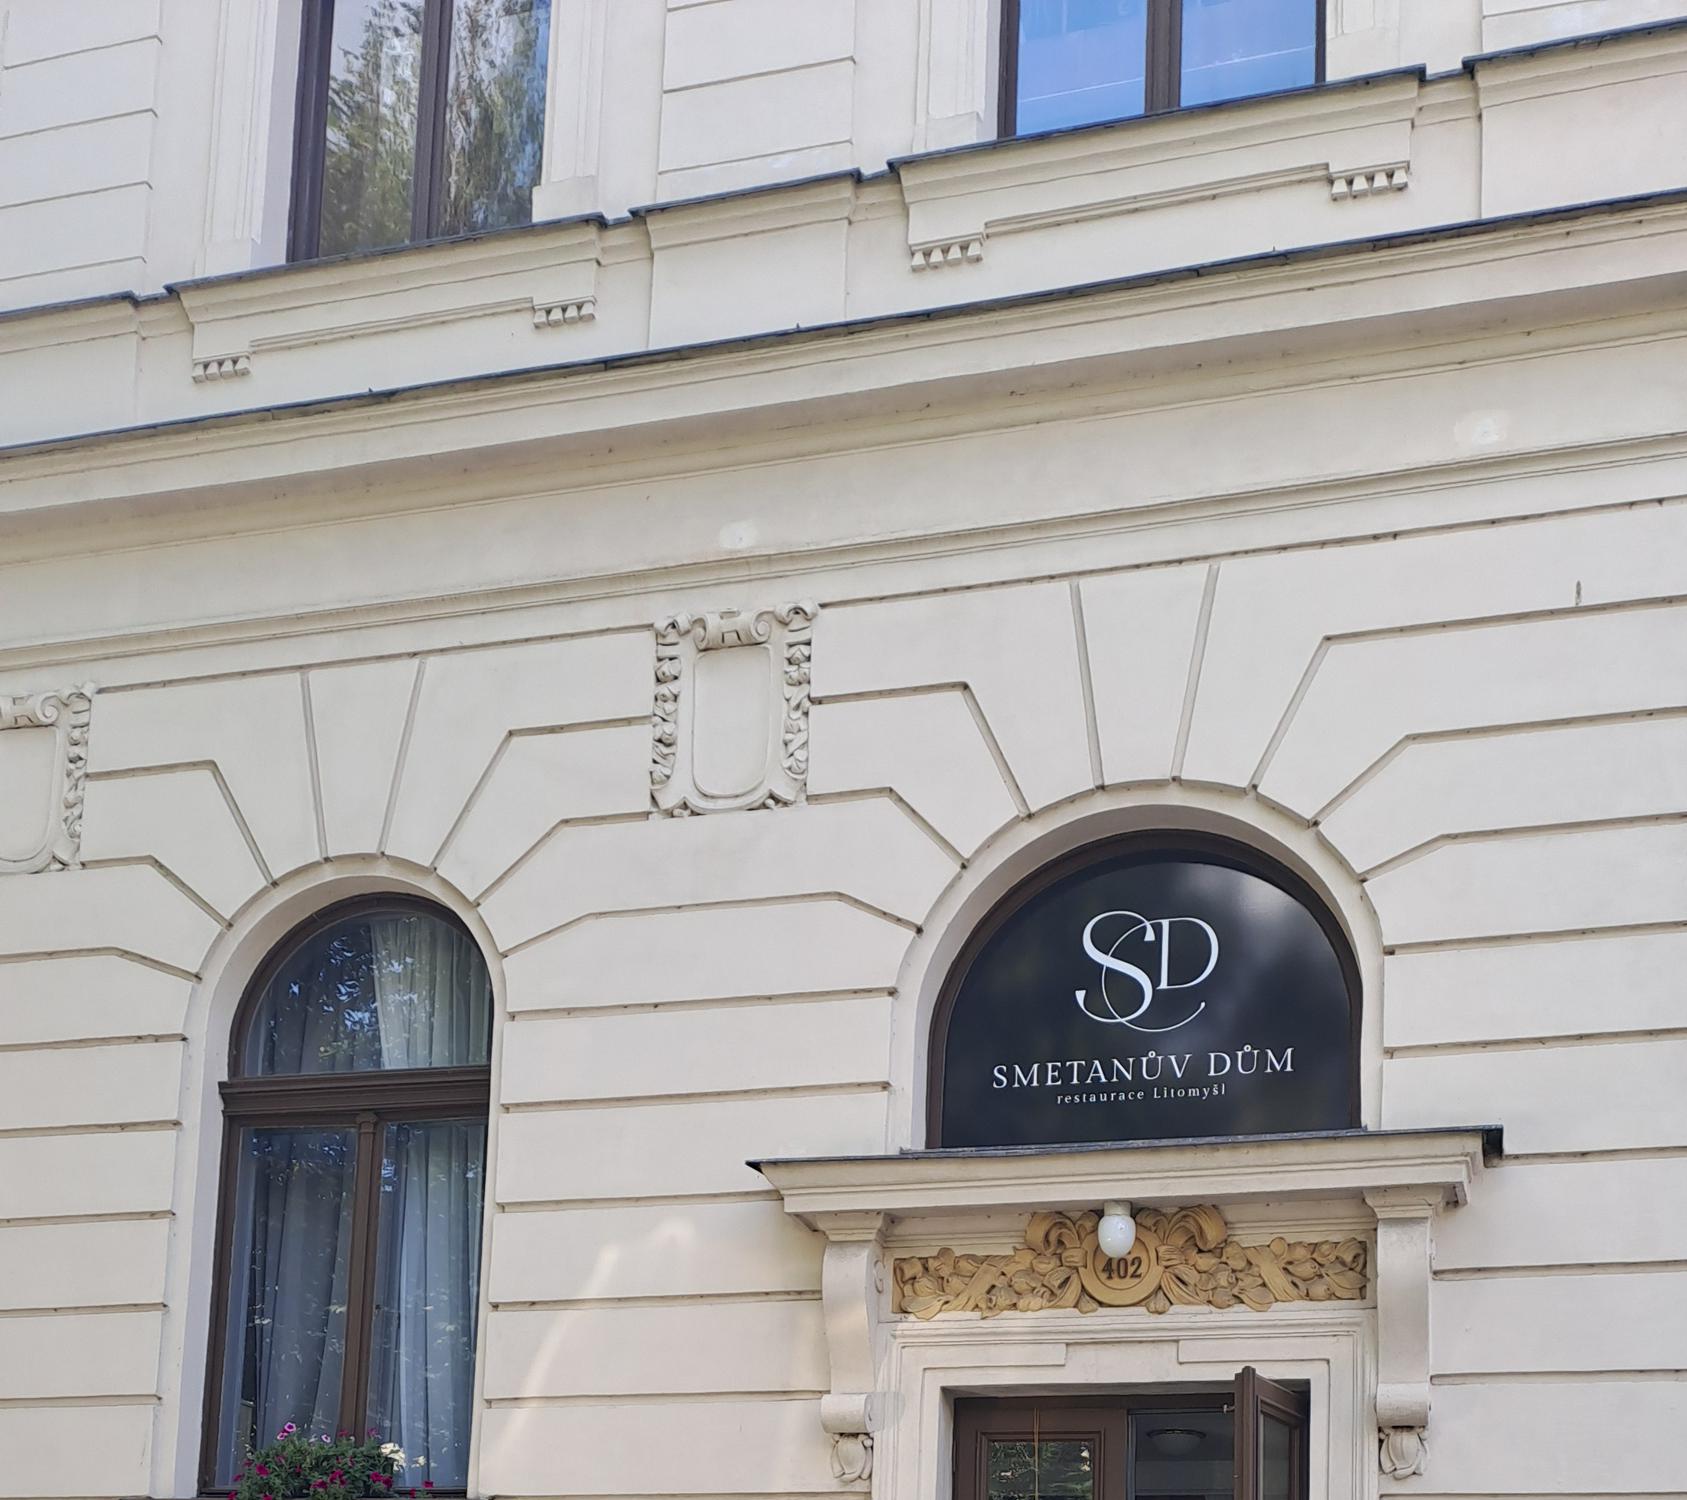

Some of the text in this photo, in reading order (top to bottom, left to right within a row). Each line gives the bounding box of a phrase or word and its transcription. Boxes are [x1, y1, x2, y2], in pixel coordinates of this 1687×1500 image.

[992, 1044, 1295, 1089] SMETANŮV DŮM
[1056, 1083, 1226, 1105] restaurace Litomyšl
[1101, 1256, 1143, 1280] 402
